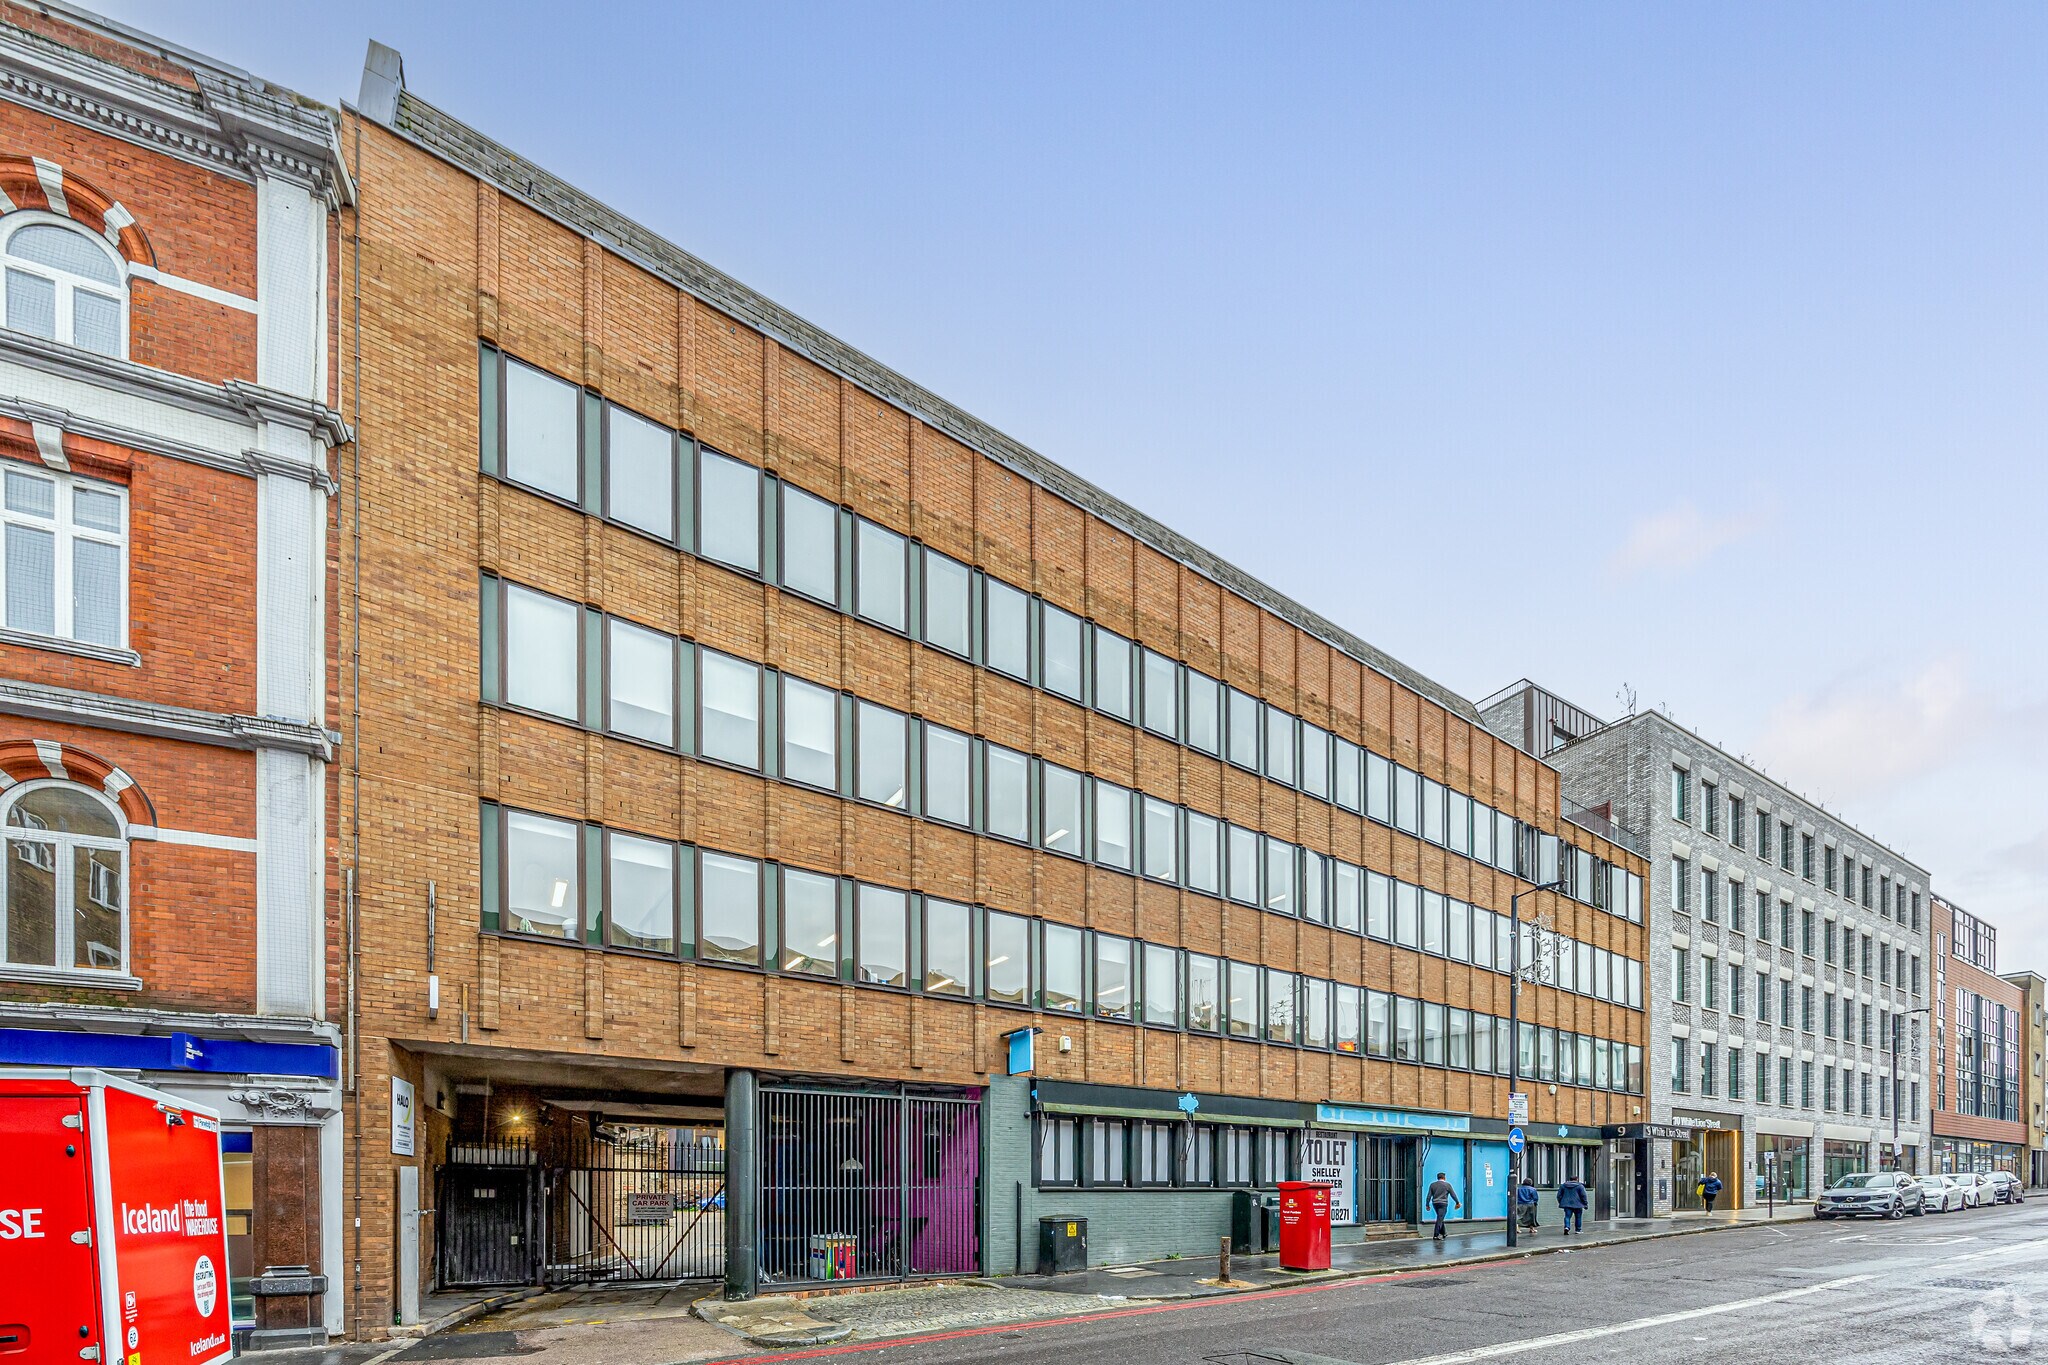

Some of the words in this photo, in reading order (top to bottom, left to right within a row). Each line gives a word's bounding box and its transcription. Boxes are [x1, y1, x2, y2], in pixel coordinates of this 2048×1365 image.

[397, 1094, 409, 1108] HALO
[1681, 1117, 1695, 1127] White
[1695, 1118, 1706, 1128] Lion
[1706, 1119, 1720, 1128] Street
[1316, 1131, 1338, 1139] RESTAURANT
[1617, 1126, 1626, 1136] 9
[1646, 1126, 1651, 1136] 9
[1652, 1126, 1665, 1137] White
[1666, 1128, 1675, 1138] Lion
[1676, 1128, 1690, 1139] Street
[1306, 1139, 1323, 1165] TO
[1326, 1140, 1347, 1166] LET
[1312, 1168, 1341, 1177] SHELLEY
[184, 1199, 194, 1217] the
[194, 1199, 208, 1217] food
[122, 1202, 180, 1234] Iceland
[185, 1218, 219, 1236] WAREHOUSE
[190, 1333, 225, 1356] Iceland.co.uk
